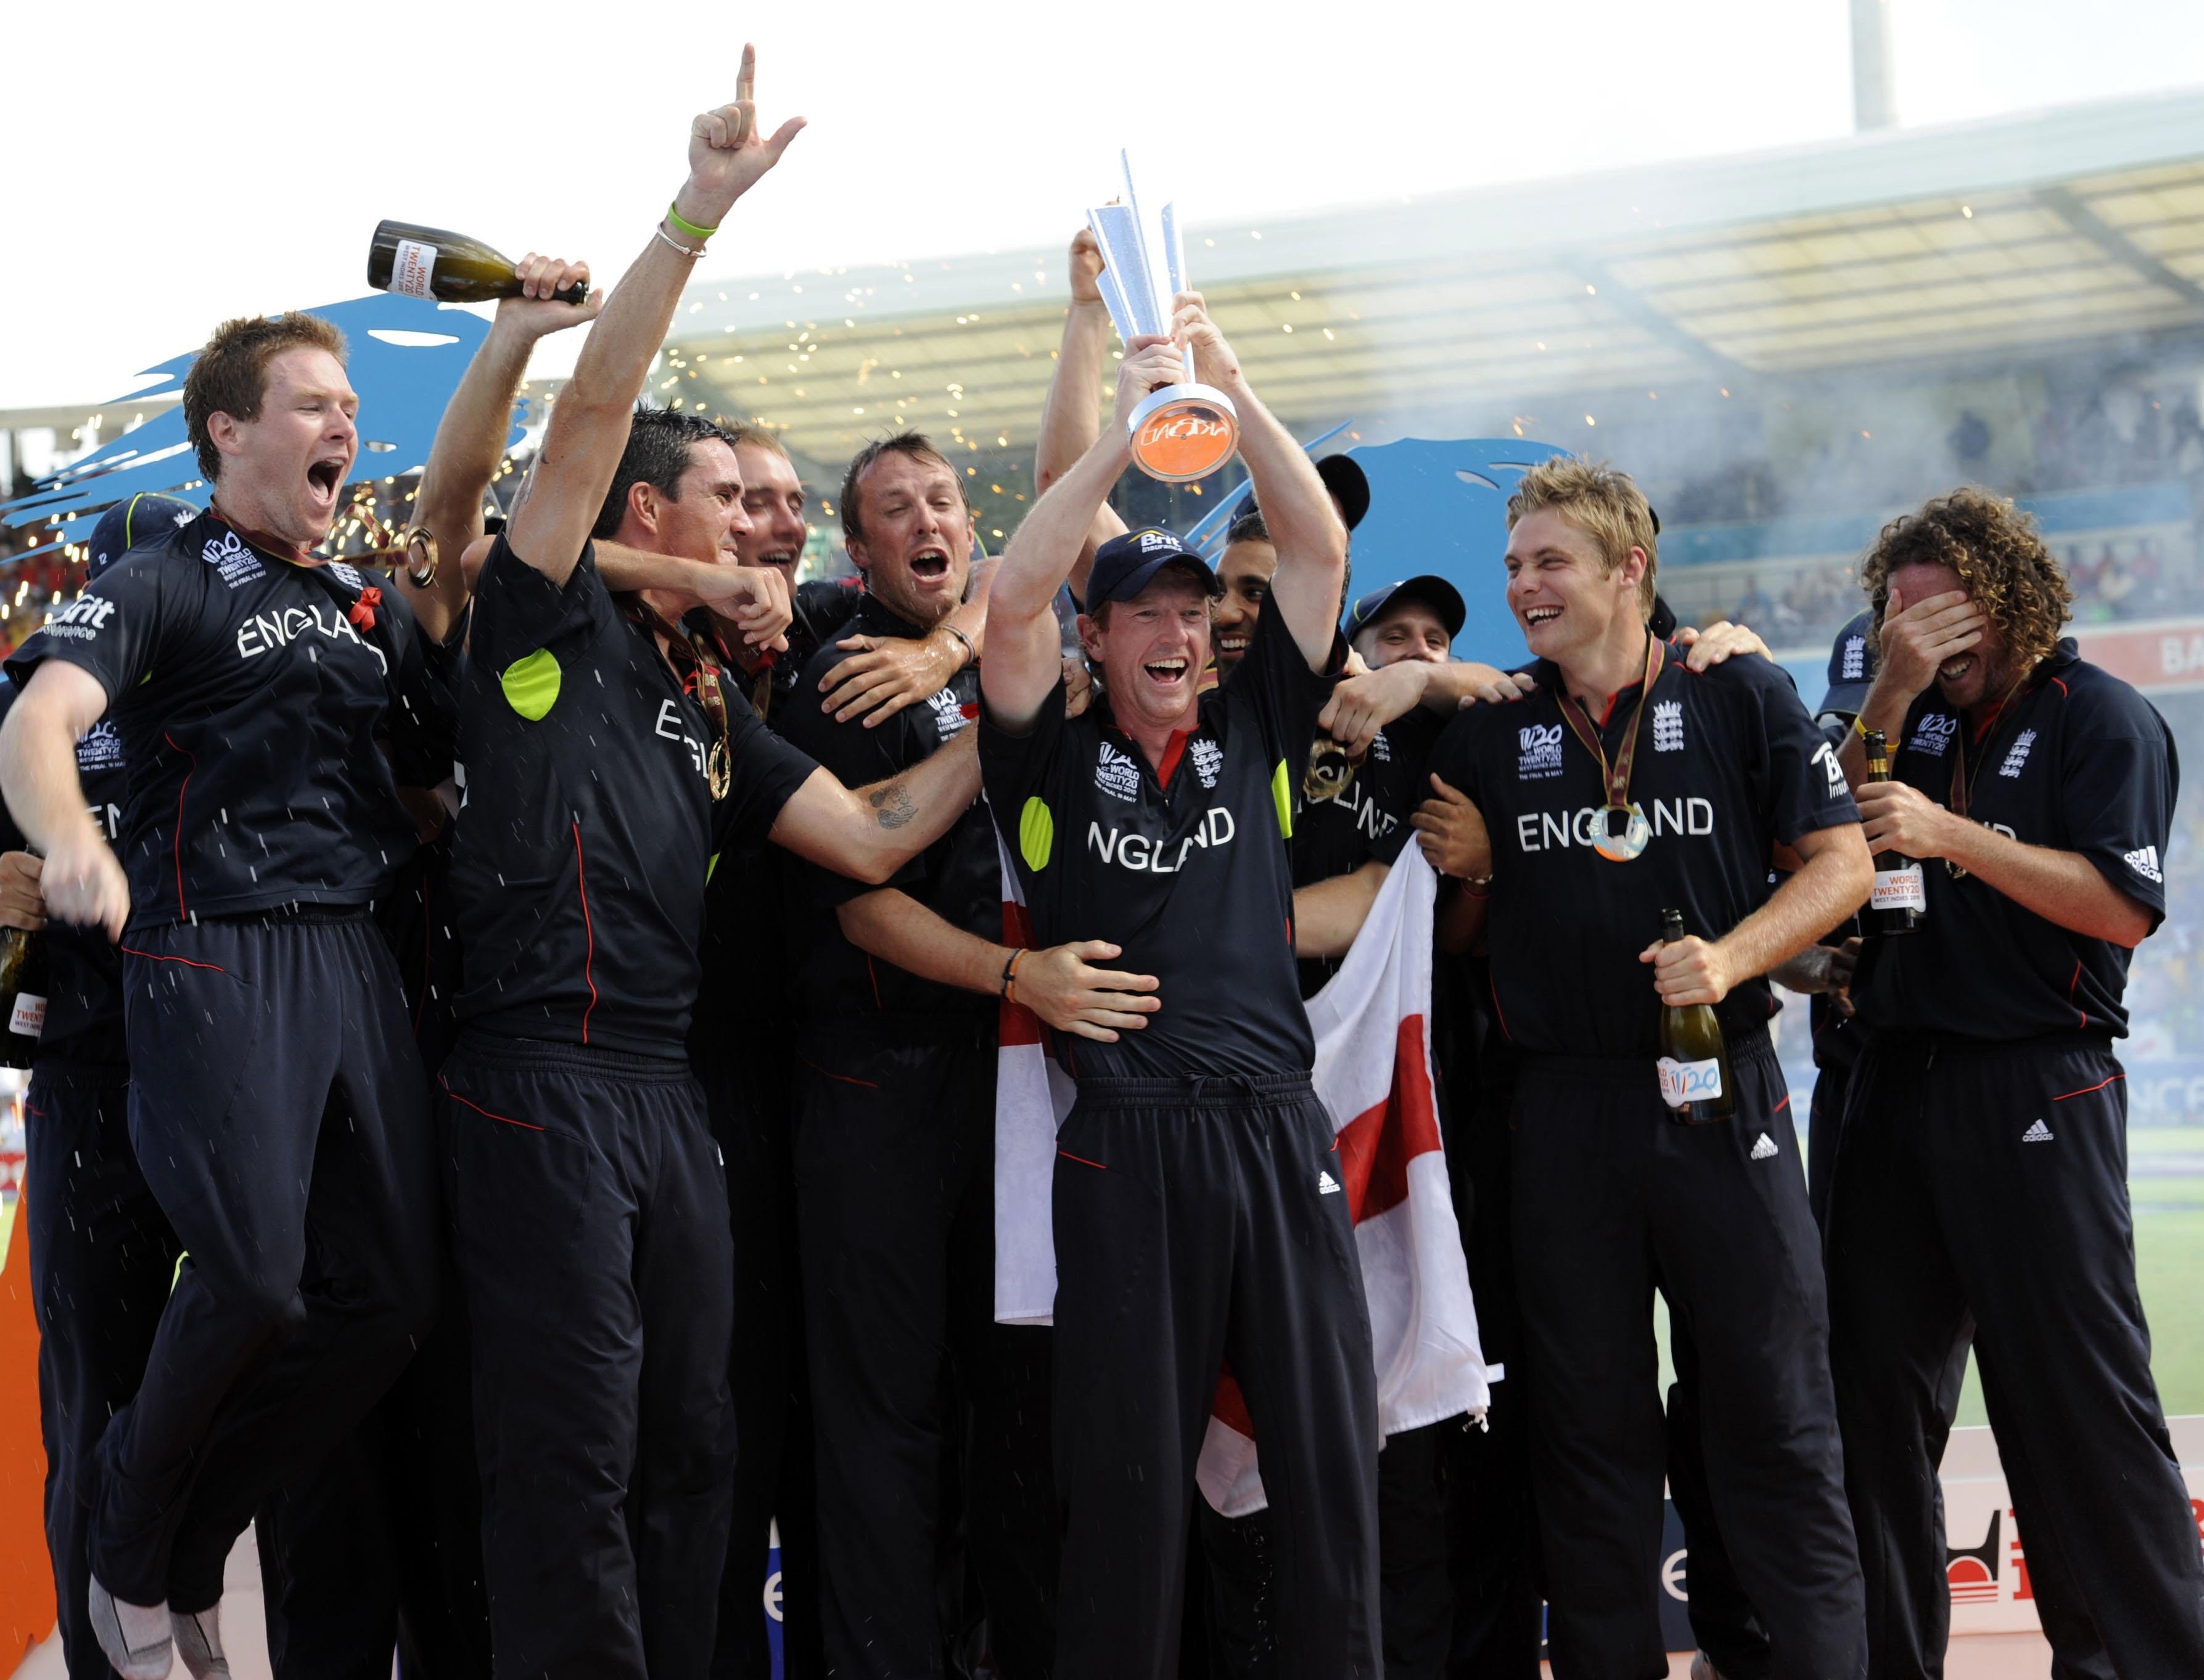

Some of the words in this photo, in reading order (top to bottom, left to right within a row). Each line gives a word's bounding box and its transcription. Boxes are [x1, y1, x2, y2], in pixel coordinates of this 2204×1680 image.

[405, 246, 421, 294] TWENTY20
[415, 266, 427, 295] WORLD
[1141, 533, 1182, 548] Brit
[224, 548, 252, 563] WORLD
[217, 555, 257, 575] TWENTY20
[1910, 737, 1946, 751] TWENTY20
[1925, 731, 1949, 744] WORLD
[1533, 744, 1562, 755] WORLD
[1518, 752, 1561, 766] TWENTY20
[1096, 766, 1138, 789] TWENTY20
[1110, 764, 1140, 780] WORLD
[1123, 786, 1137, 795] 2010
[1124, 795, 1137, 803] MAY
[2124, 853, 2162, 884] adidas
[1889, 875, 1918, 884] WORLD
[1873, 885, 1920, 896] TWENTY20
[2023, 1133, 2054, 1142] adidas
